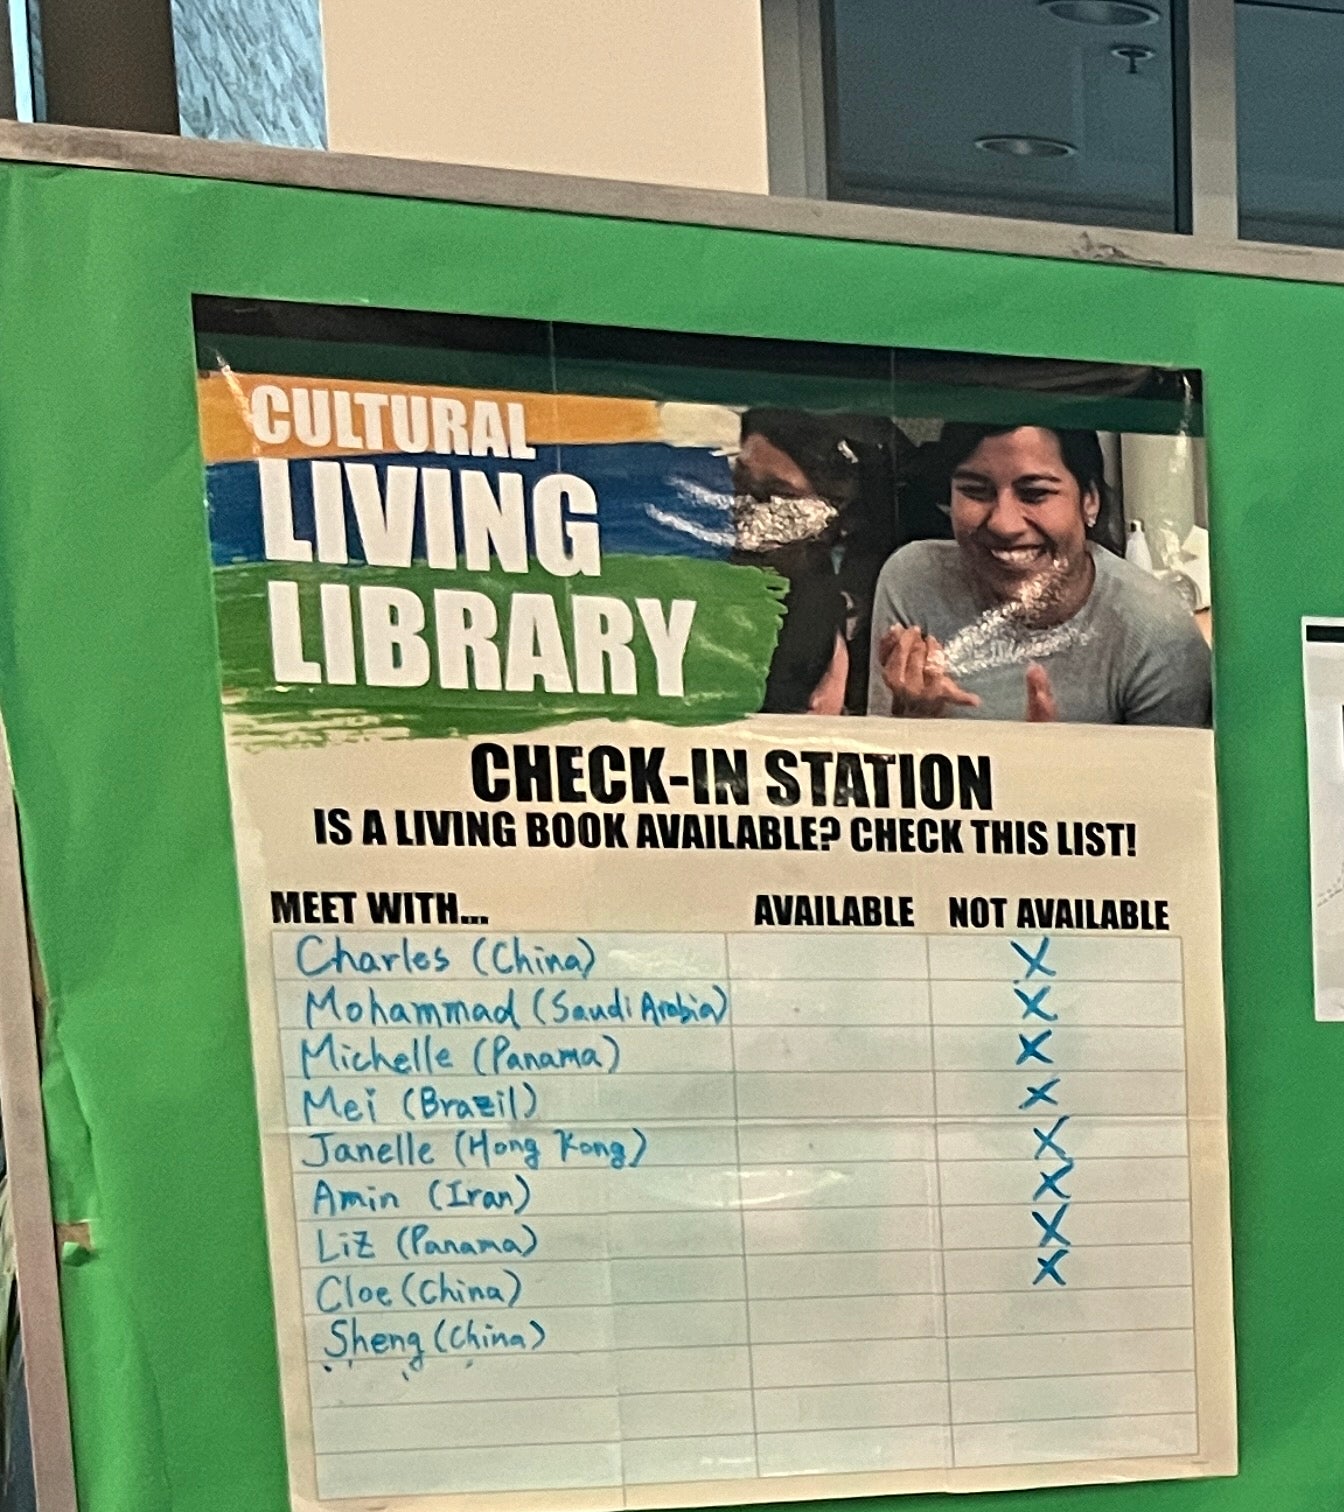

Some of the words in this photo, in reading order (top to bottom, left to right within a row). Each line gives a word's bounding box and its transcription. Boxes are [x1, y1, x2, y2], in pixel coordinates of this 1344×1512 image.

[250, 384, 536, 460] CULTURAL
[258, 456, 601, 577] LIVING
[267, 580, 698, 698] LIBRARY
[471, 742, 750, 806] CHECK-IN
[764, 748, 994, 811] STATION
[314, 807, 353, 846] IS
[362, 808, 387, 846] A
[395, 809, 517, 848] LIVING
[526, 811, 629, 849] BOOK
[636, 812, 841, 852] AVAILABLE?
[850, 816, 965, 854] CHECK
[970, 818, 1050, 857] THIS
[1056, 821, 1137, 858] LIST!
[271, 890, 357, 925] MEET
[366, 891, 490, 926] WITH...
[754, 893, 915, 927] AVAILABLE
[948, 895, 1008, 929] NOT
[1016, 897, 1171, 931] AVAILABLE
[296, 933, 452, 977] Charles
[472, 935, 597, 979] (China)
[305, 984, 521, 1030] Mohammad
[532, 985, 632, 1025] (Saudi
[299, 1027, 454, 1080] Michelle
[473, 1034, 621, 1076] (Panama)
[303, 1085, 378, 1127] Mei
[403, 1081, 538, 1121] (Brazil)
[301, 1130, 435, 1167] Janelle
[454, 1128, 541, 1171] (Hong
[553, 1127, 648, 1170] Kong)
[313, 1179, 401, 1217] Amin
[428, 1174, 532, 1215] (Iran)
[396, 1224, 539, 1261] (Panama)
[316, 1273, 394, 1314] Cloe
[401, 1268, 523, 1309] (China)
[323, 1316, 426, 1373] Sheng
[433, 1318, 547, 1354] (China)
